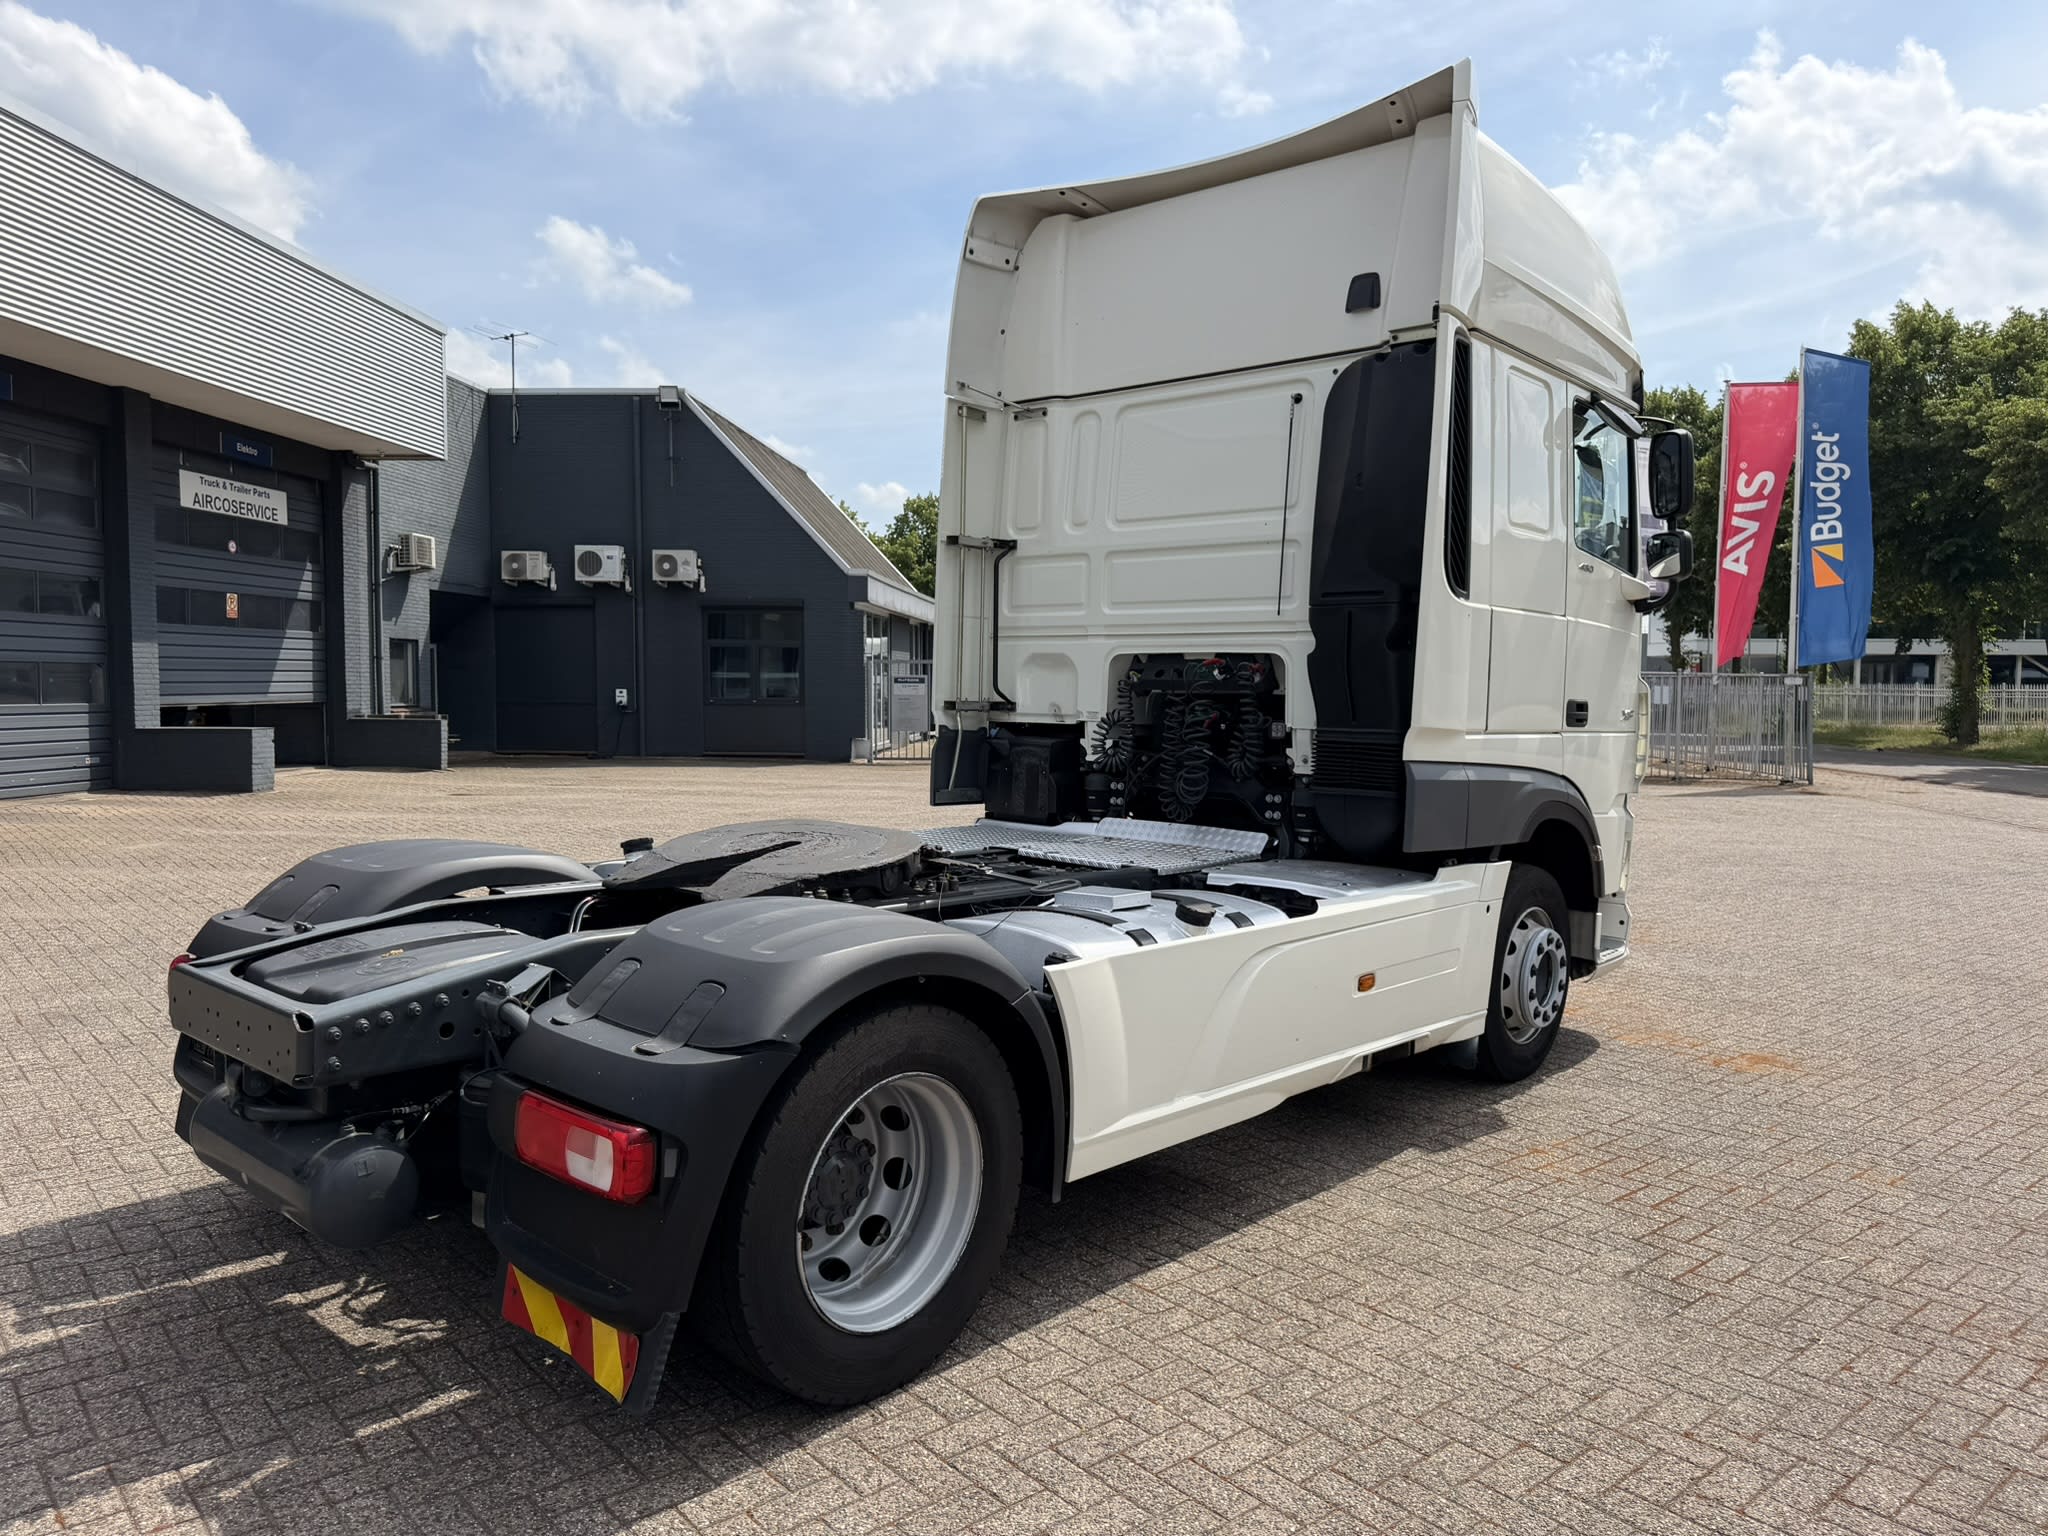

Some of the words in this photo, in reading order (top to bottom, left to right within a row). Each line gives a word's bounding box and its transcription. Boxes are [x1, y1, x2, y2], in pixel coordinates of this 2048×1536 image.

[236, 442, 258, 456] Elektro
[199, 476, 220, 489] Truck
[222, 481, 227, 490] &
[229, 483, 252, 495] Trailer
[252, 488, 271, 500] Parts
[1810, 431, 1851, 542] Budget
[192, 492, 279, 522] AIRCOSERVICE
[1722, 470, 1776, 576] AVIS
